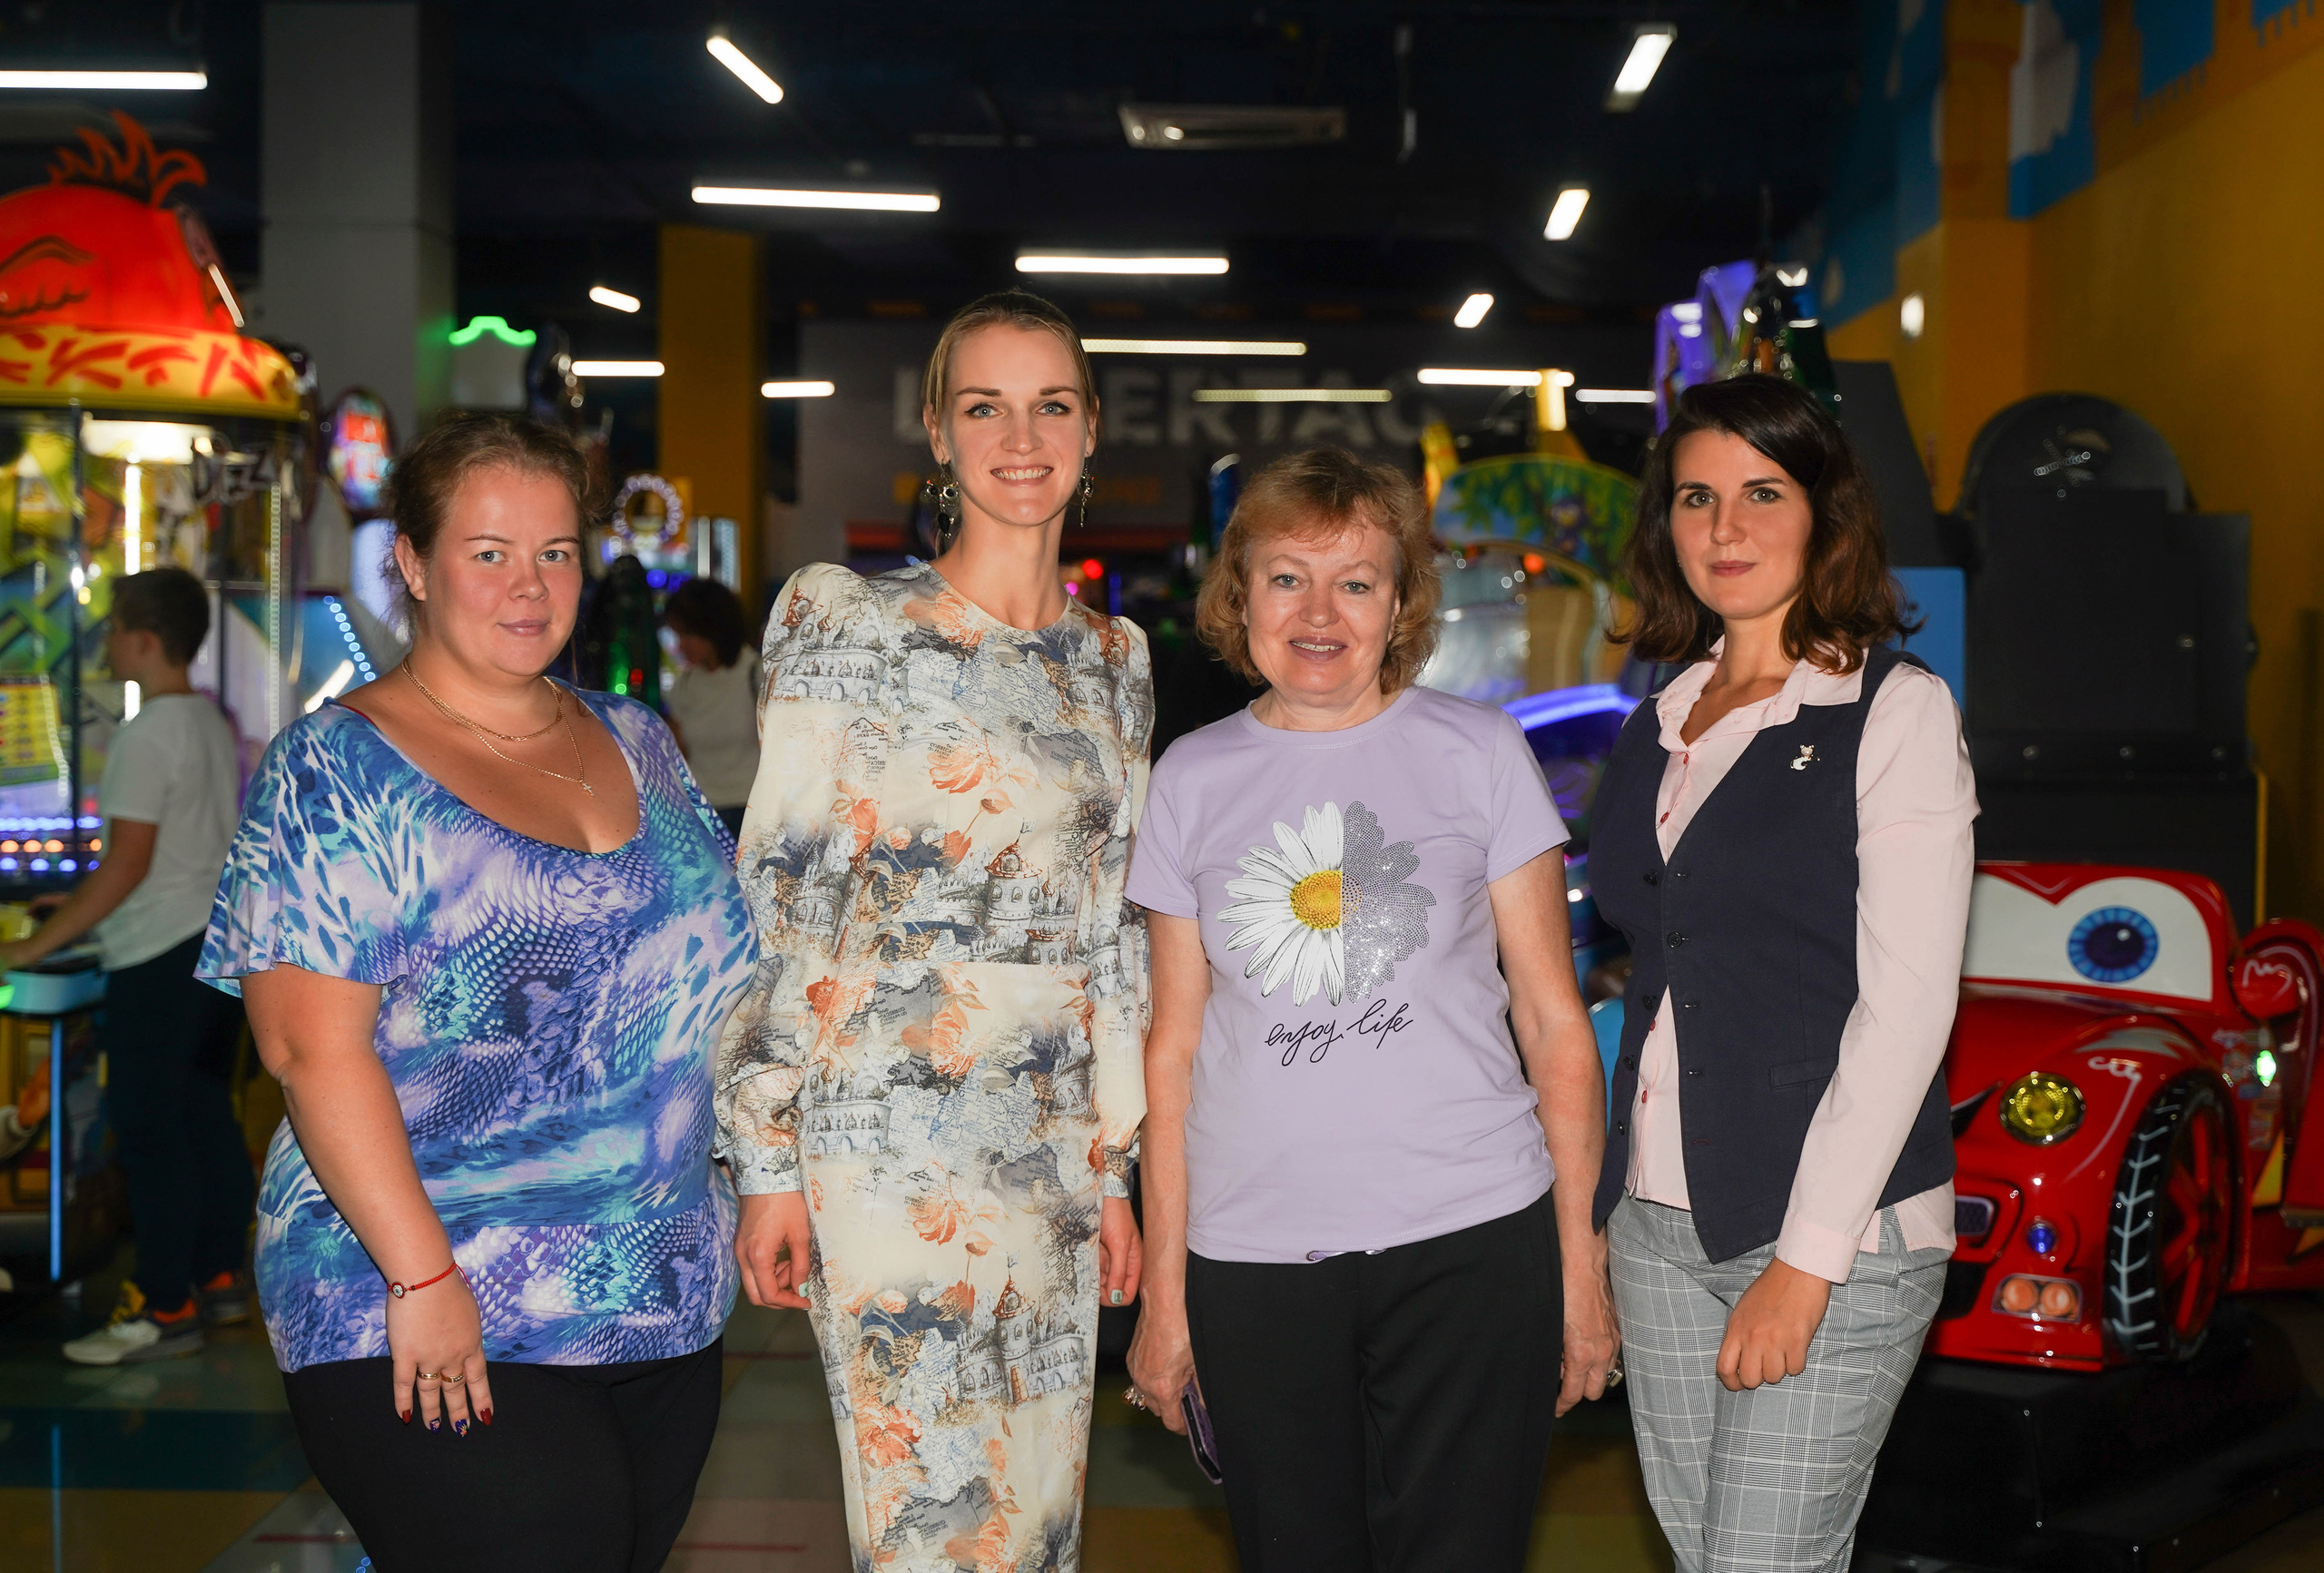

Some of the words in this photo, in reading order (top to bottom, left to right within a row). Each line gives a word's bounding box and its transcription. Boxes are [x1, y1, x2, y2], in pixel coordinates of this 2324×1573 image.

[893, 367, 1450, 445] LERTAG
[1265, 1019, 1344, 1067] enjoy
[1346, 998, 1413, 1049] life
